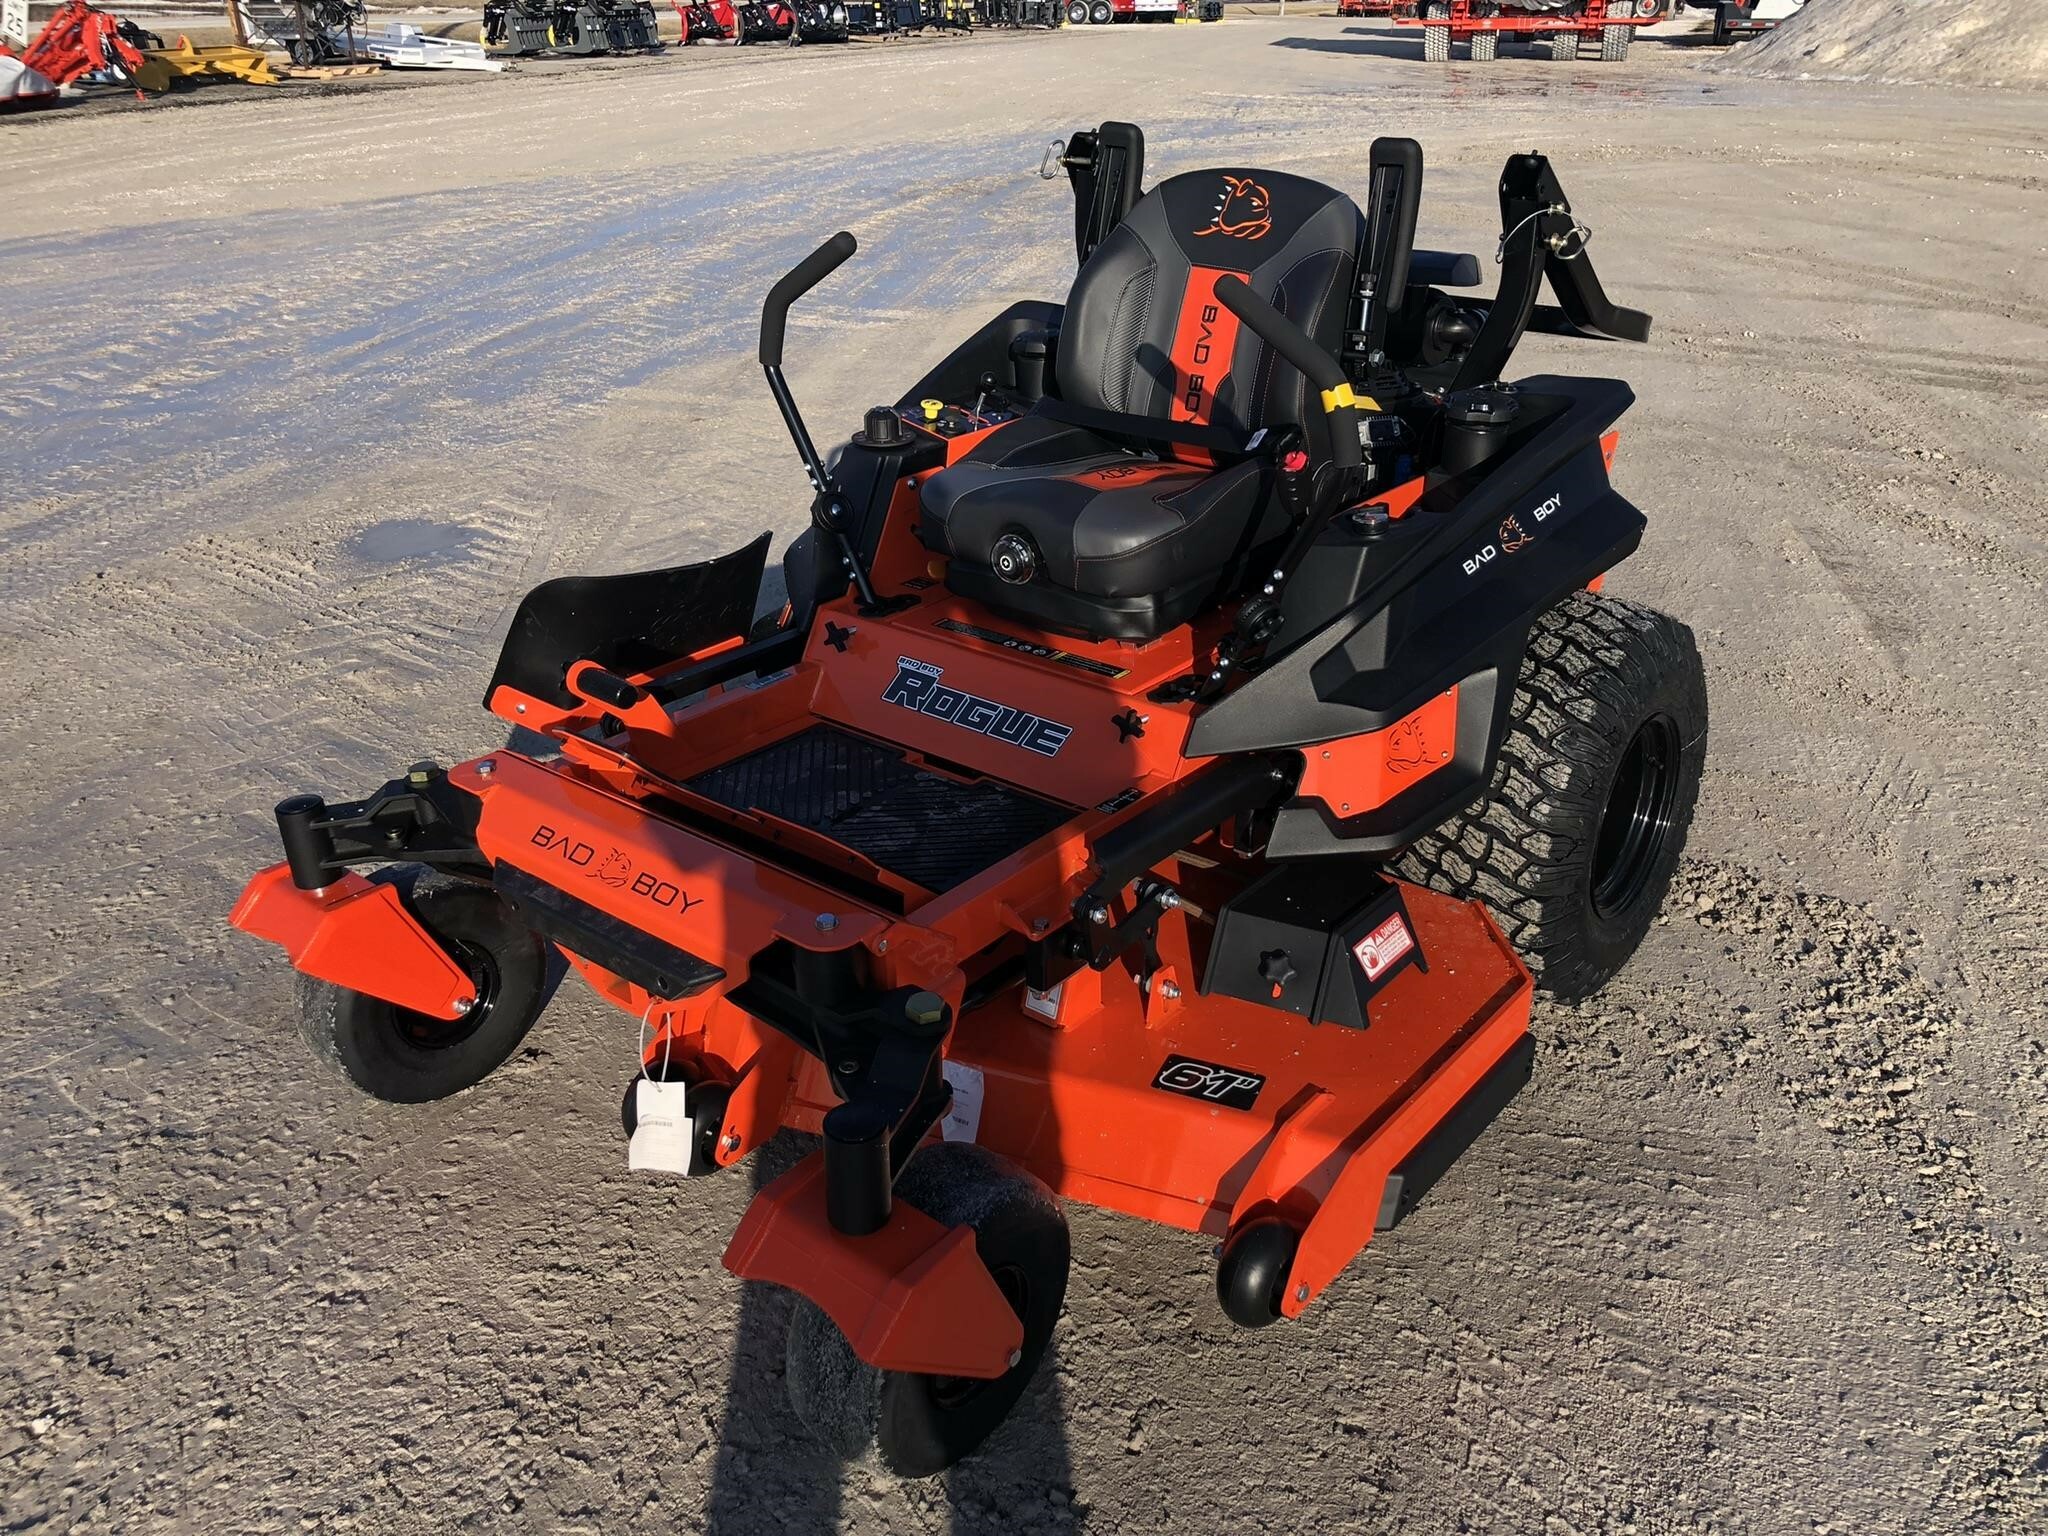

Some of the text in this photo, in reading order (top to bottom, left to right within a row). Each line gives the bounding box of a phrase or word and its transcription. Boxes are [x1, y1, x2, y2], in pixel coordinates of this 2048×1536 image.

[7, 12, 24, 37] 25
[1193, 304, 1219, 364] BAD
[1462, 493, 1561, 575] BAD BOY
[899, 657, 943, 676] BAD BOY
[881, 664, 1073, 757] ROGUE
[530, 824, 704, 915] BAD BOY
[1379, 917, 1402, 940] DANGER
